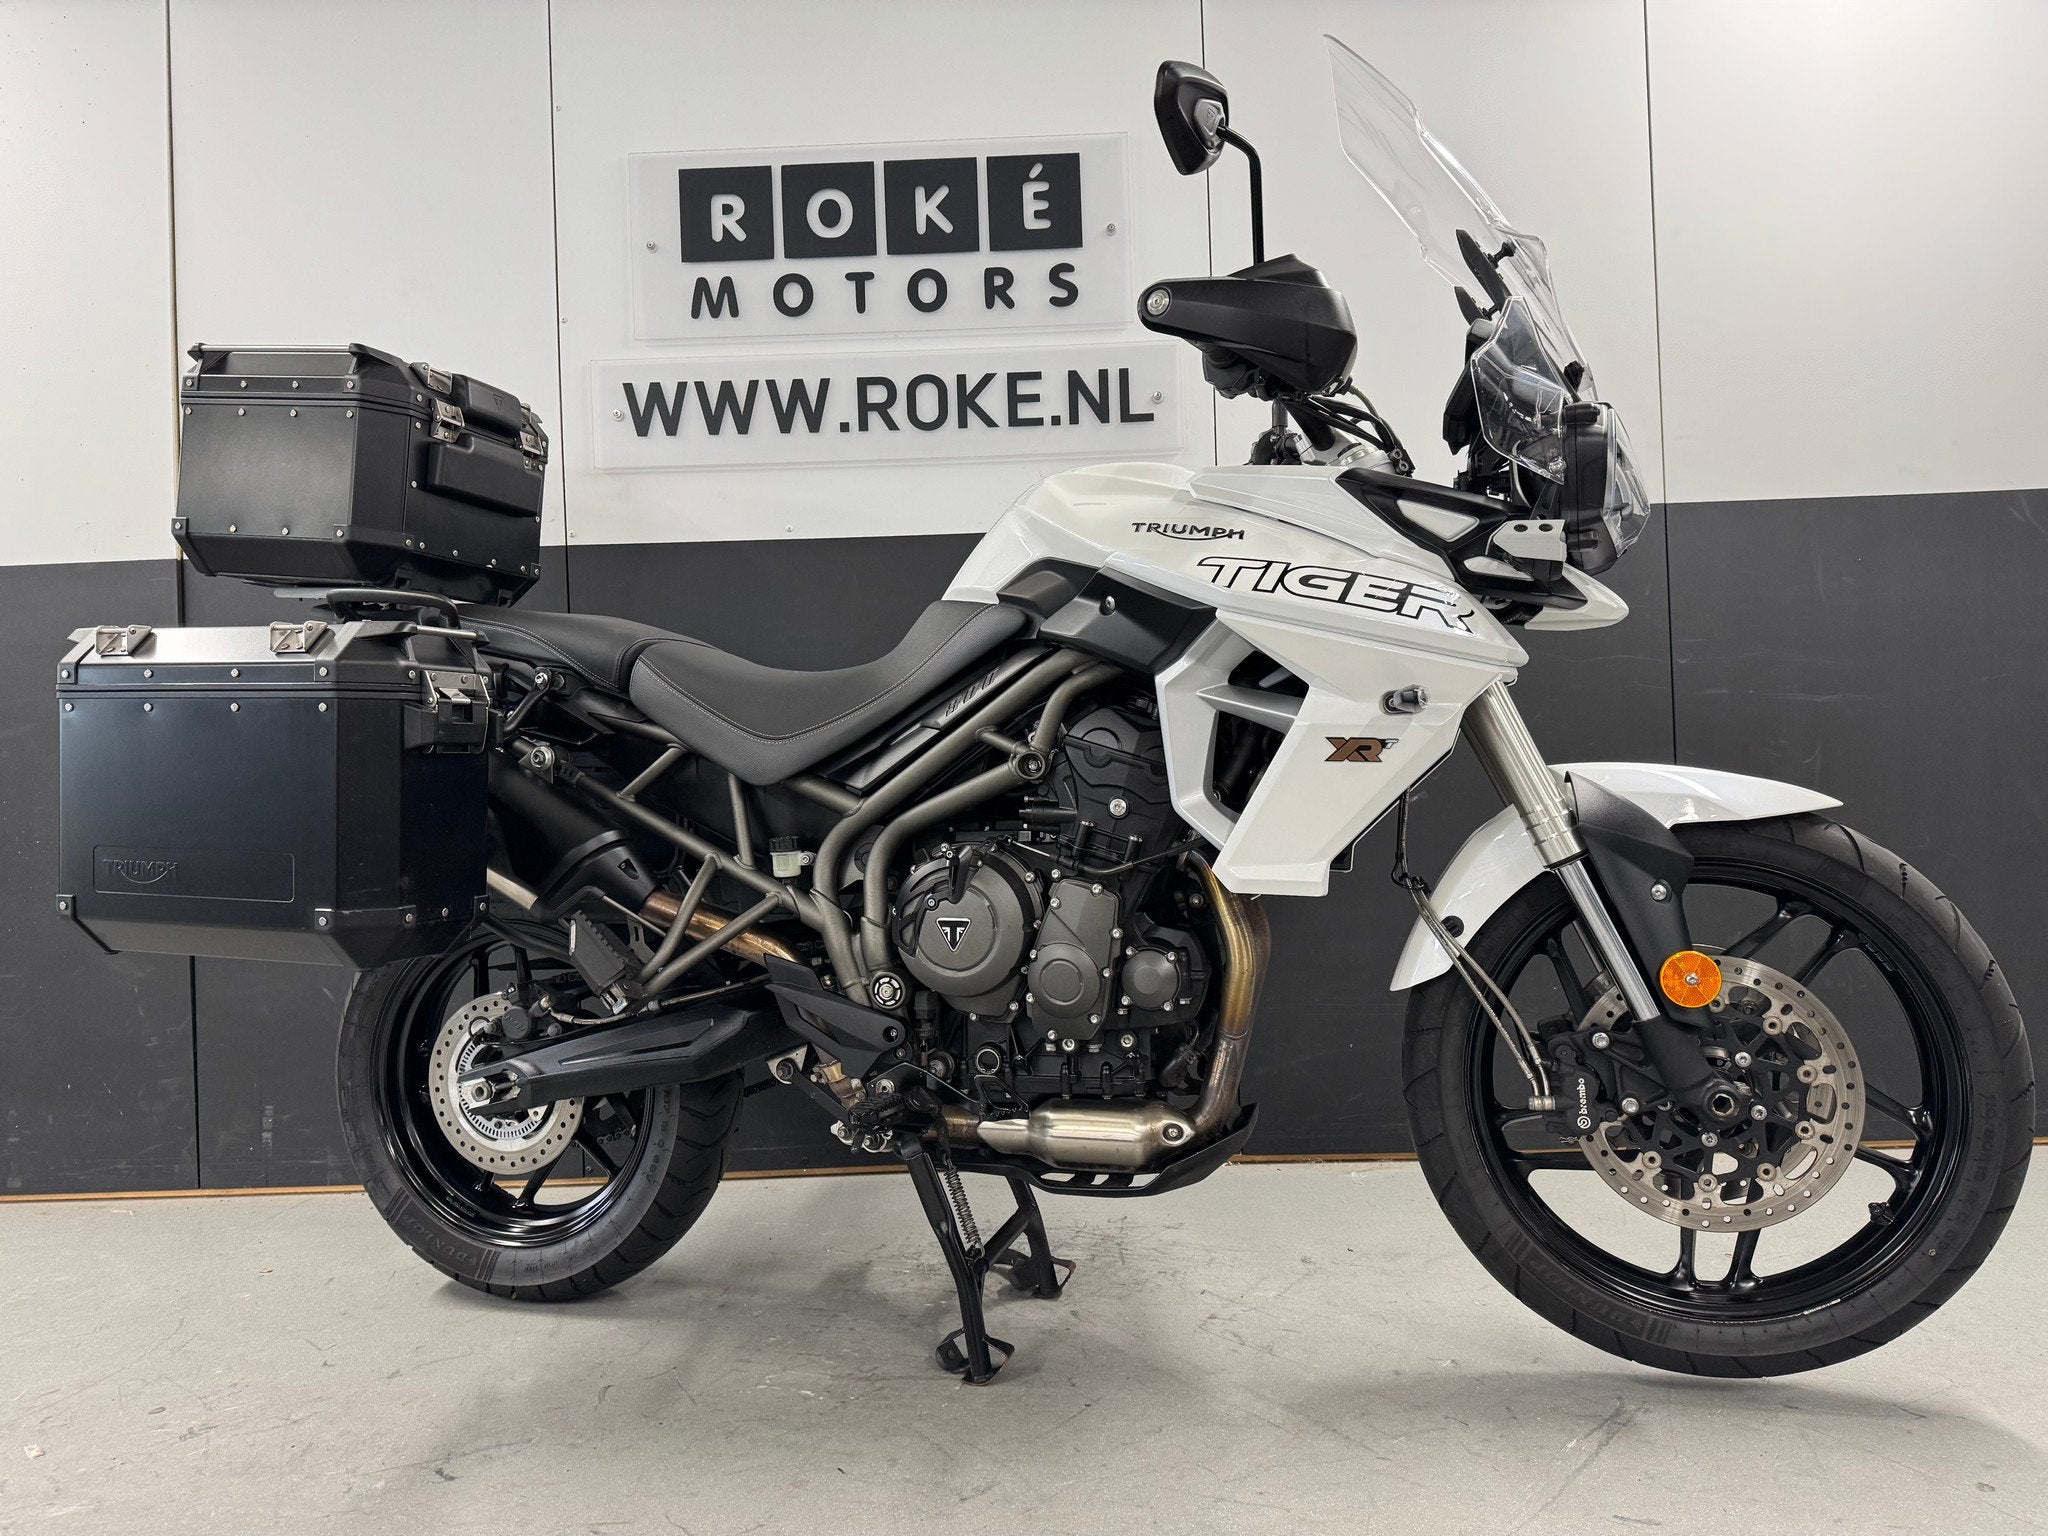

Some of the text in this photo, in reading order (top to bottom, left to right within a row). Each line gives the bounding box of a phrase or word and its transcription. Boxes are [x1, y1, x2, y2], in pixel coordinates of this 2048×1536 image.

[711, 162, 1052, 243] ROKÉ
[691, 262, 1080, 320] MOTORS
[622, 367, 1156, 438] WWW.ROKE.NL
[1131, 522, 1245, 541] TRIUMPH
[1196, 556, 1479, 638] TIGER
[103, 858, 179, 882] TRIUMPH
[1578, 1077, 1588, 1115] brembo
